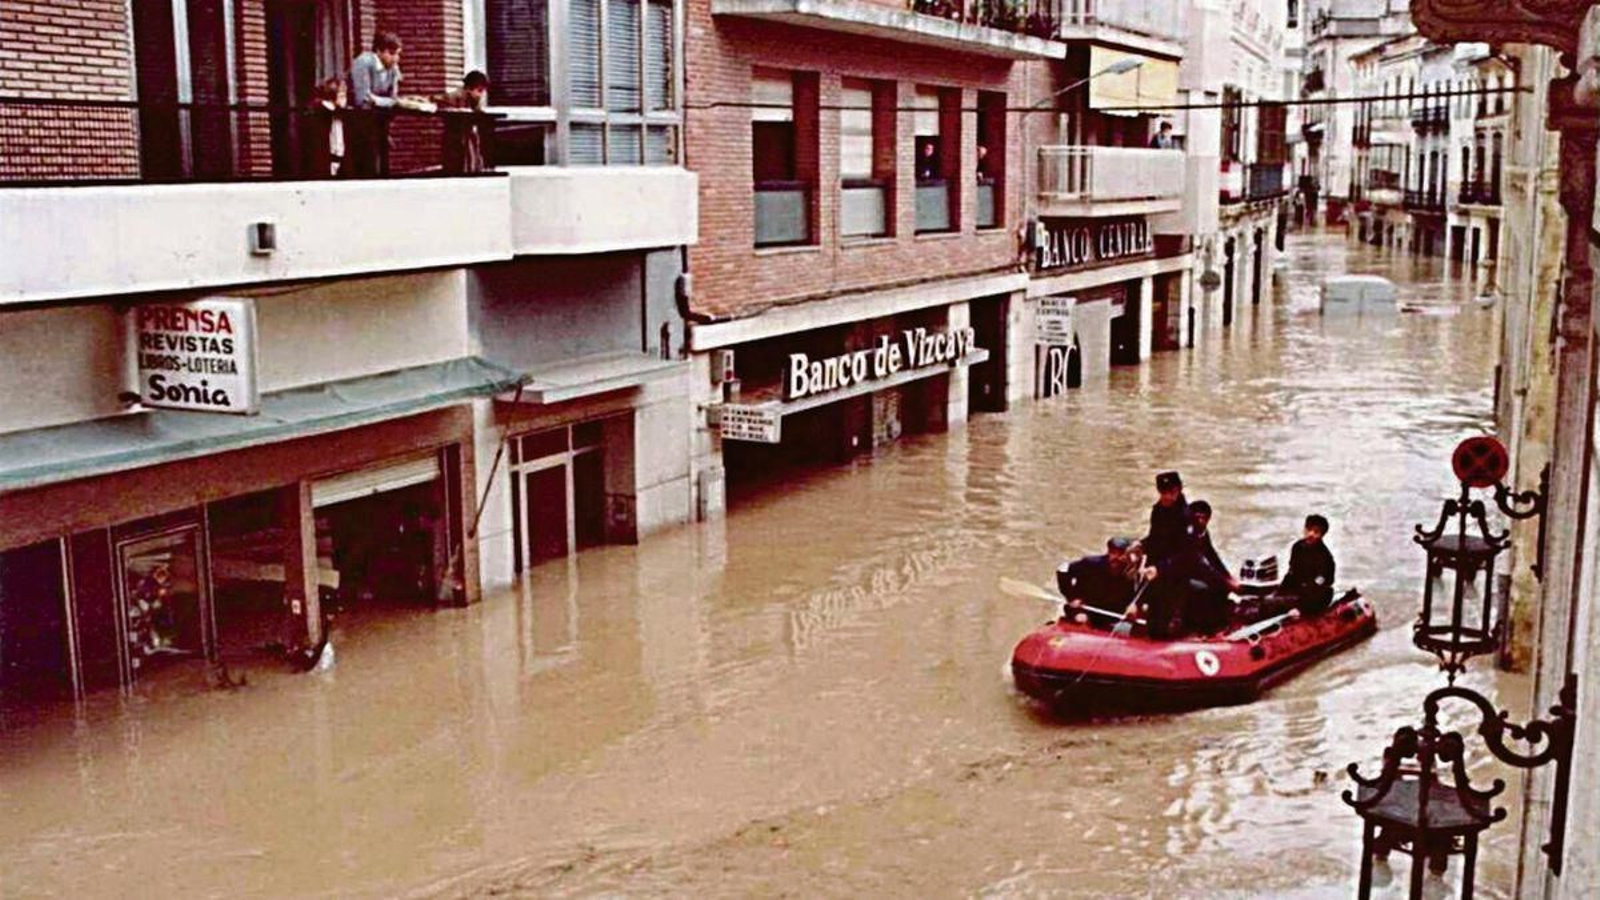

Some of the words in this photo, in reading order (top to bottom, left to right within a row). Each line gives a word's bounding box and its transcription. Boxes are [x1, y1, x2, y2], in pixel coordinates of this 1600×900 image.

[1041, 226, 1090, 268] BANCO
[1100, 221, 1154, 258] CENTRAL
[139, 305, 232, 334] PRENSA
[139, 332, 234, 355] REVISTAS
[139, 352, 238, 375] LIBROS-LOTERIA
[789, 351, 867, 399] Banco
[874, 334, 903, 378] de
[903, 326, 976, 370] Vizcaya
[149, 374, 230, 406] Sonia
